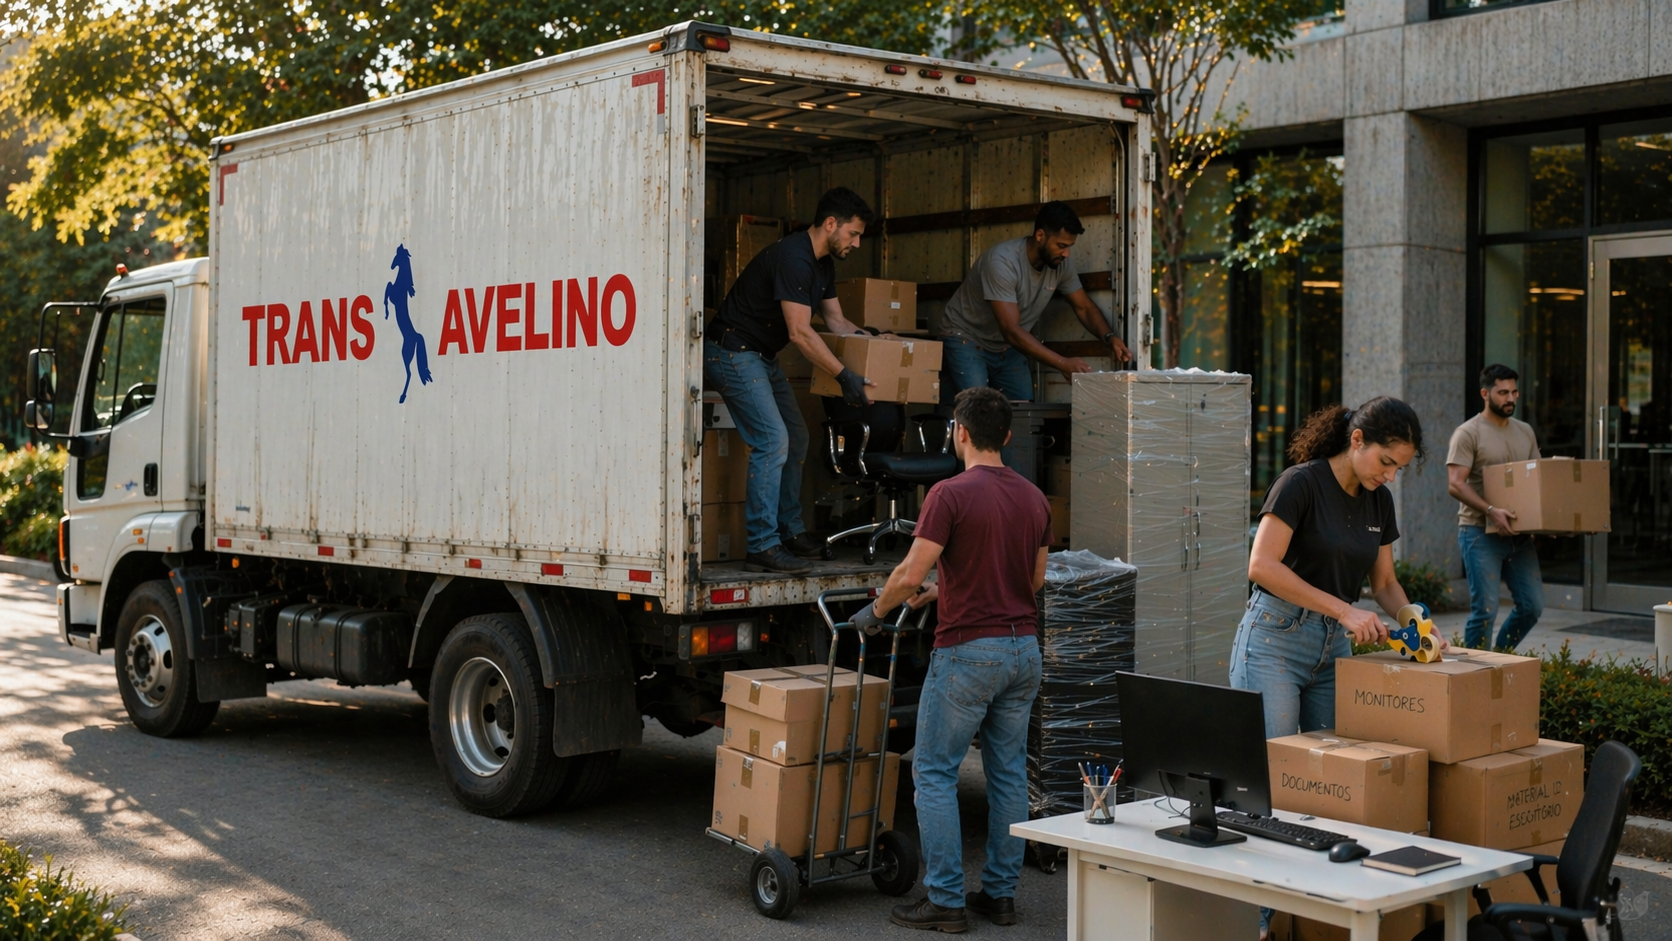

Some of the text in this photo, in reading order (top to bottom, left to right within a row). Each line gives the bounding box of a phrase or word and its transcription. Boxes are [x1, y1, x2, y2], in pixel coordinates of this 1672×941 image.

[242, 273, 637, 366] TRANS AVELINO
[1354, 689, 1425, 714] MONITORES
[1281, 772, 1351, 802] DOCUMENTOS
